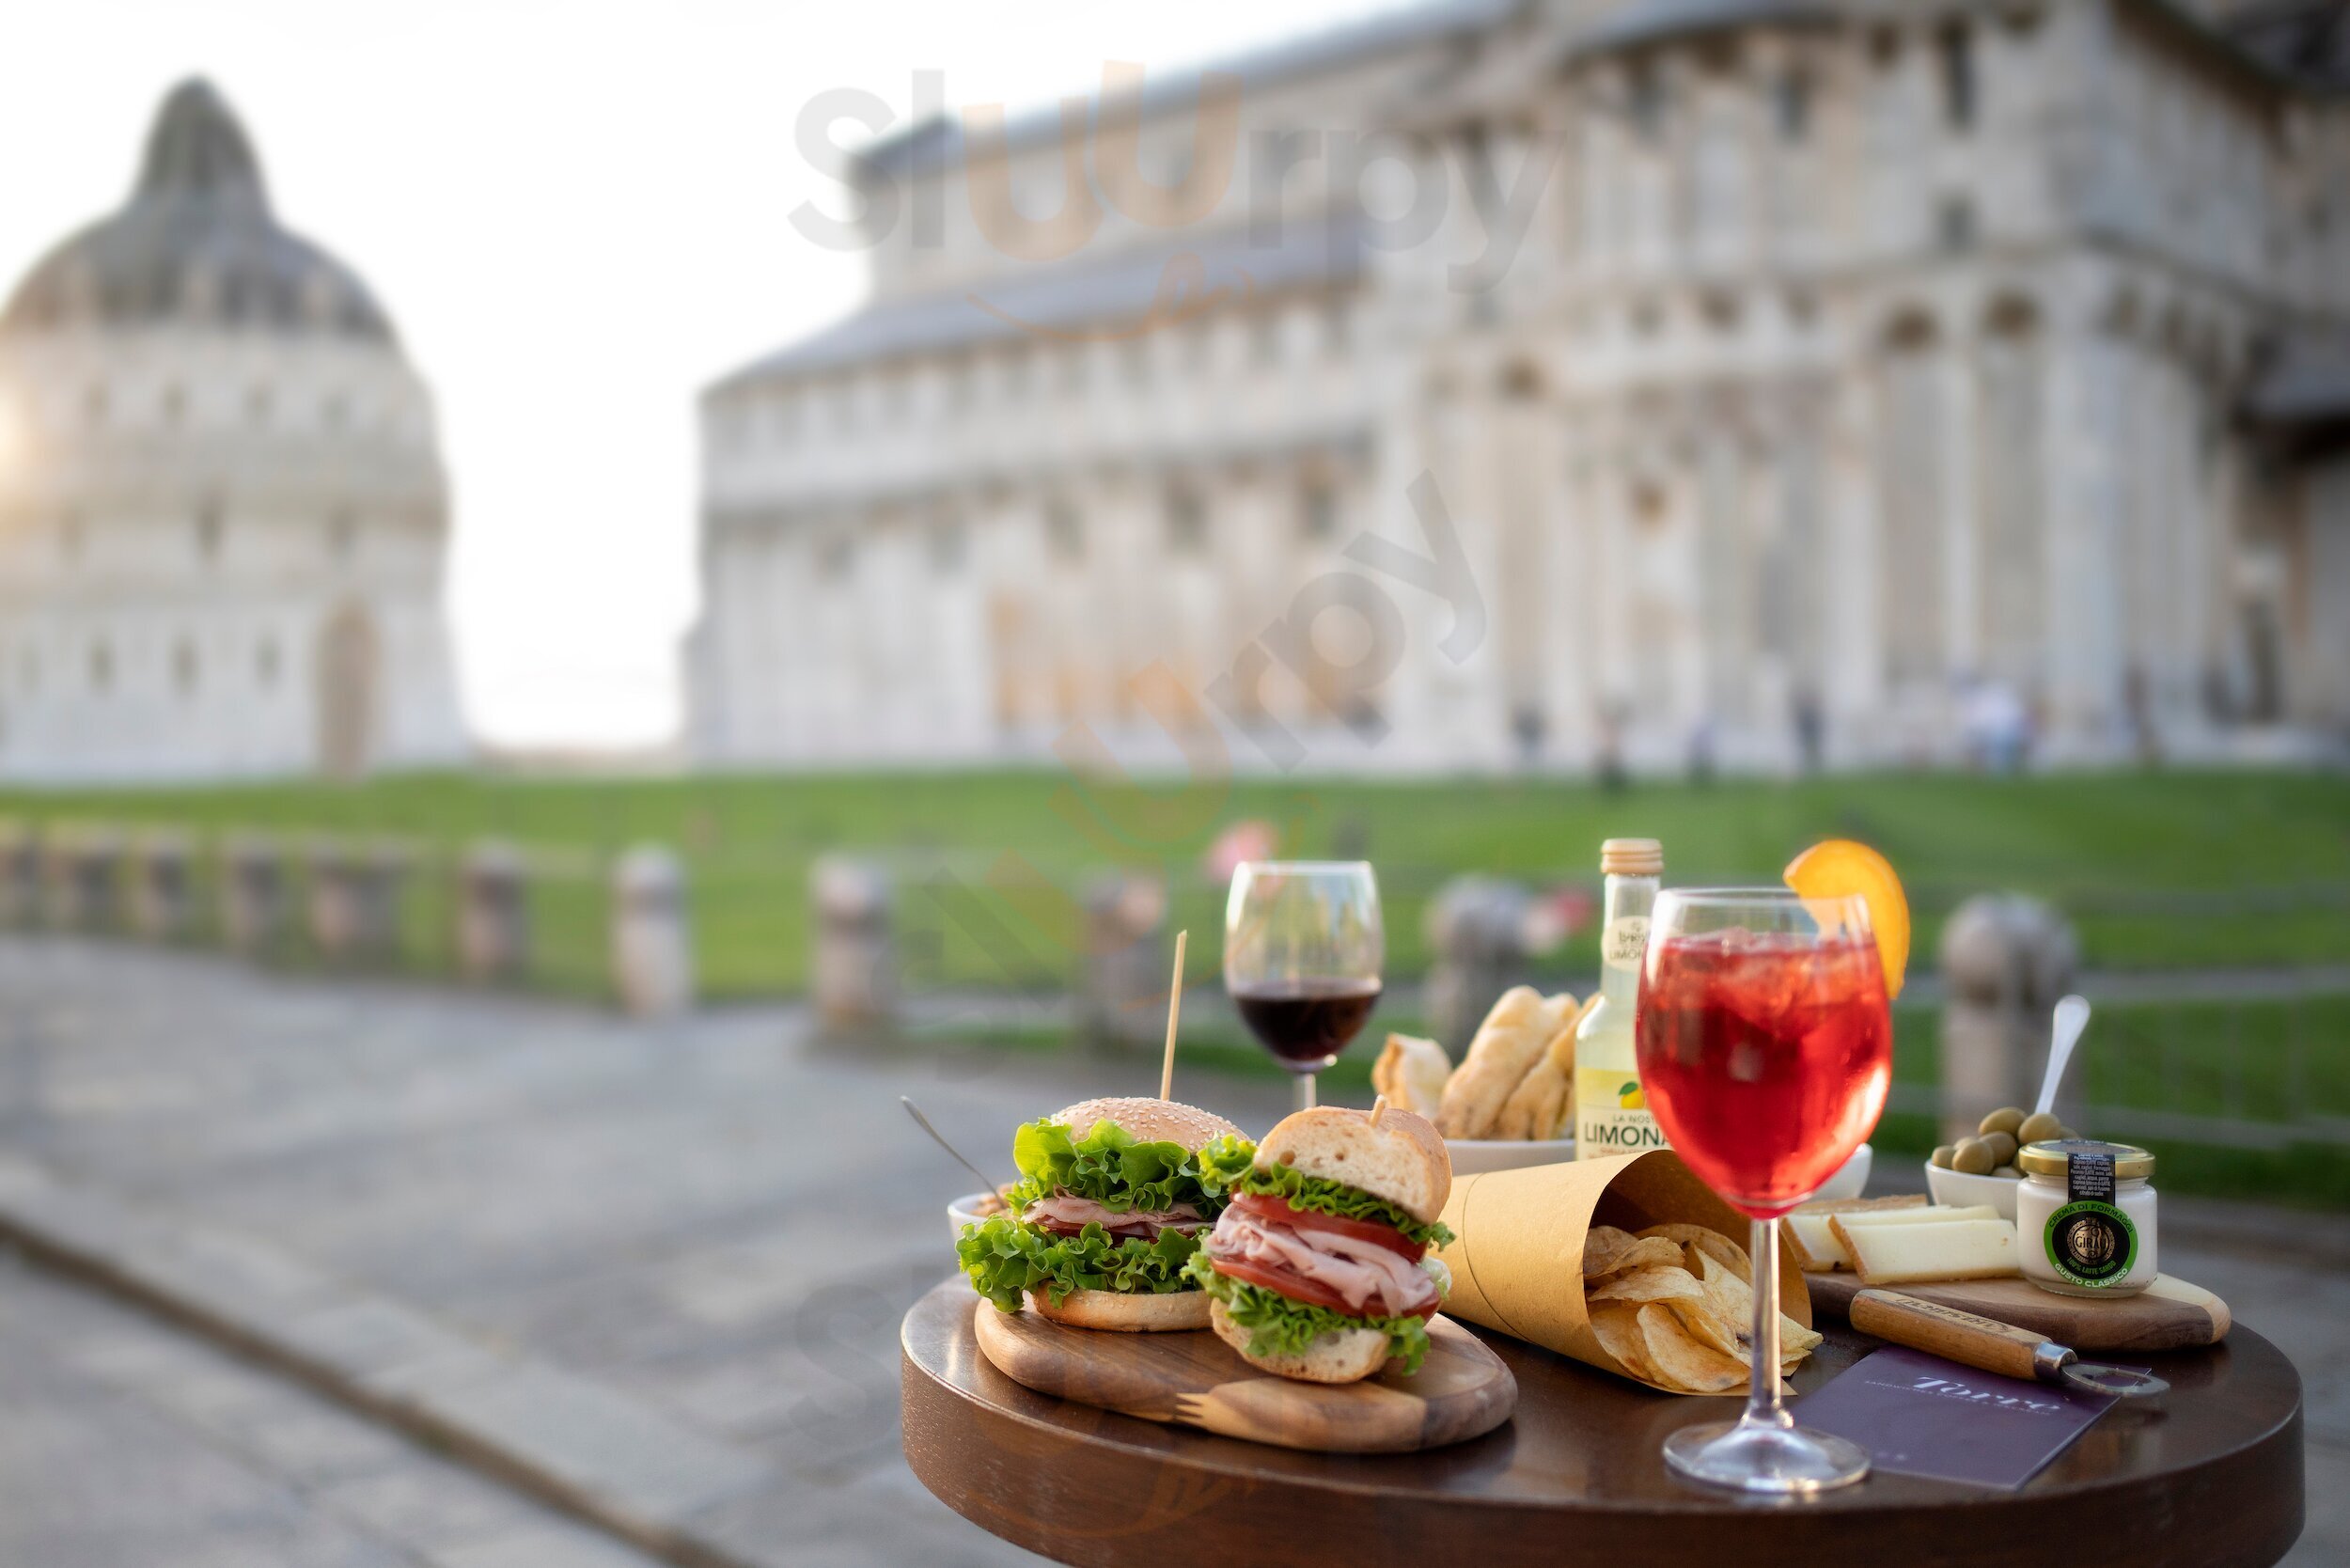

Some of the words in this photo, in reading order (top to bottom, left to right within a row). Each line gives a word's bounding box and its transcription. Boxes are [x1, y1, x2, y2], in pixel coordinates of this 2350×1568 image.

[1613, 1114, 1624, 1122] LA
[2049, 1207, 2076, 1228] CREMA
[2091, 1204, 2133, 1232] FORMAGGI
[2055, 1263, 2082, 1284] GUSTO
[2085, 1268, 2127, 1287] CLASSICO
[1912, 1376, 2061, 1410] Torre
